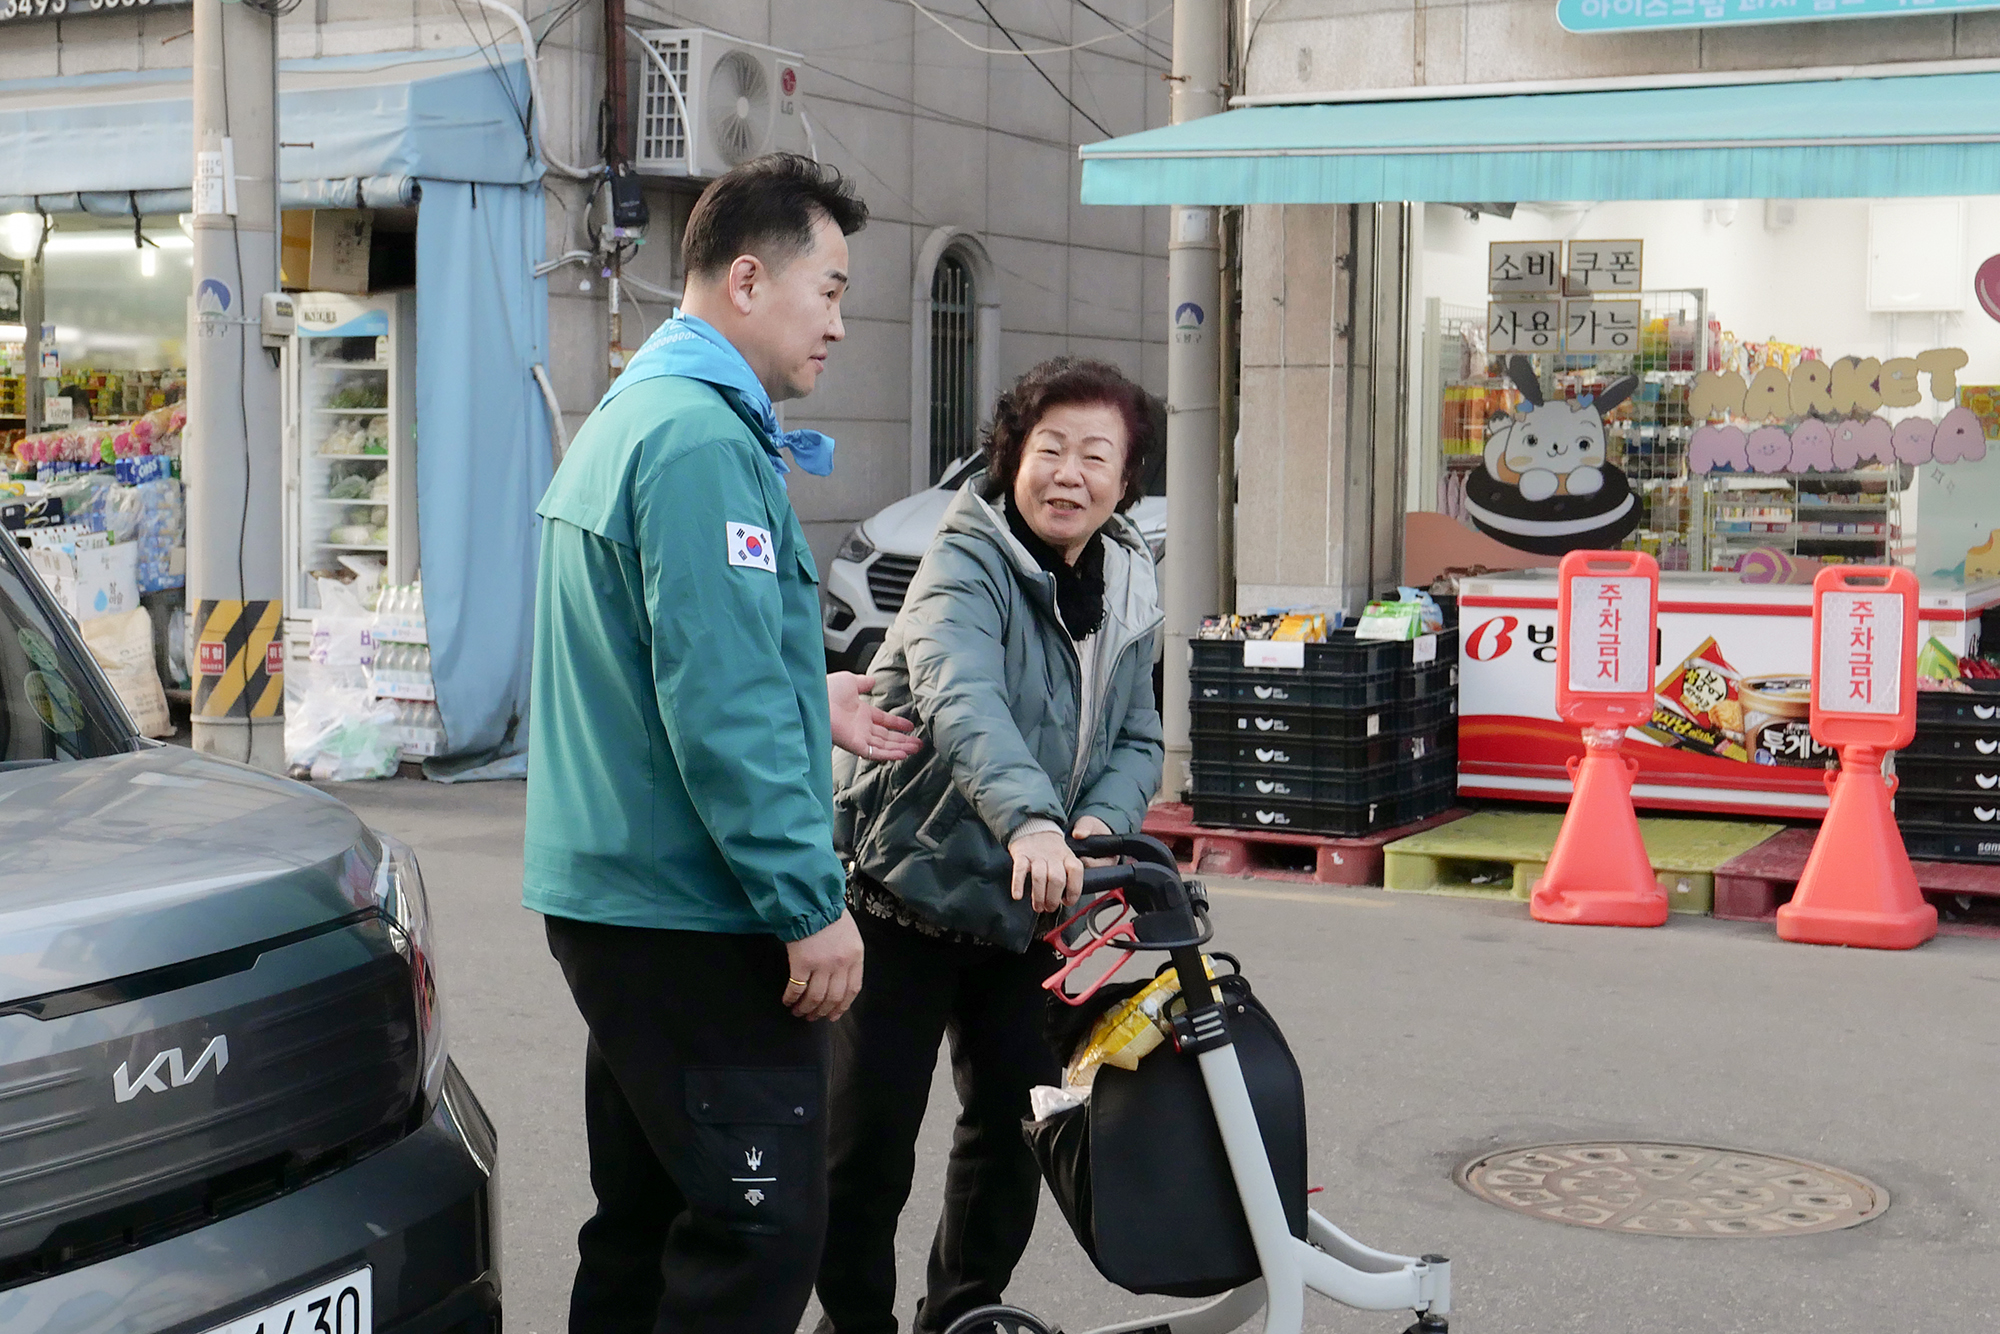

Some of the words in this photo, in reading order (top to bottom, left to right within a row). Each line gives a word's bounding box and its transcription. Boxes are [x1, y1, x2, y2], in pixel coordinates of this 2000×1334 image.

[781, 100, 794, 115] LG
[1492, 250, 1555, 286] 소비
[1570, 251, 1639, 286] 쿠폰
[1490, 310, 1557, 346] 사용
[1569, 309, 1637, 346] 가능
[1688, 347, 1969, 422] MARKET
[1597, 584, 1623, 683] 주차금지
[1849, 600, 1875, 704] 주차금지
[113, 1034, 229, 1103] KIA
